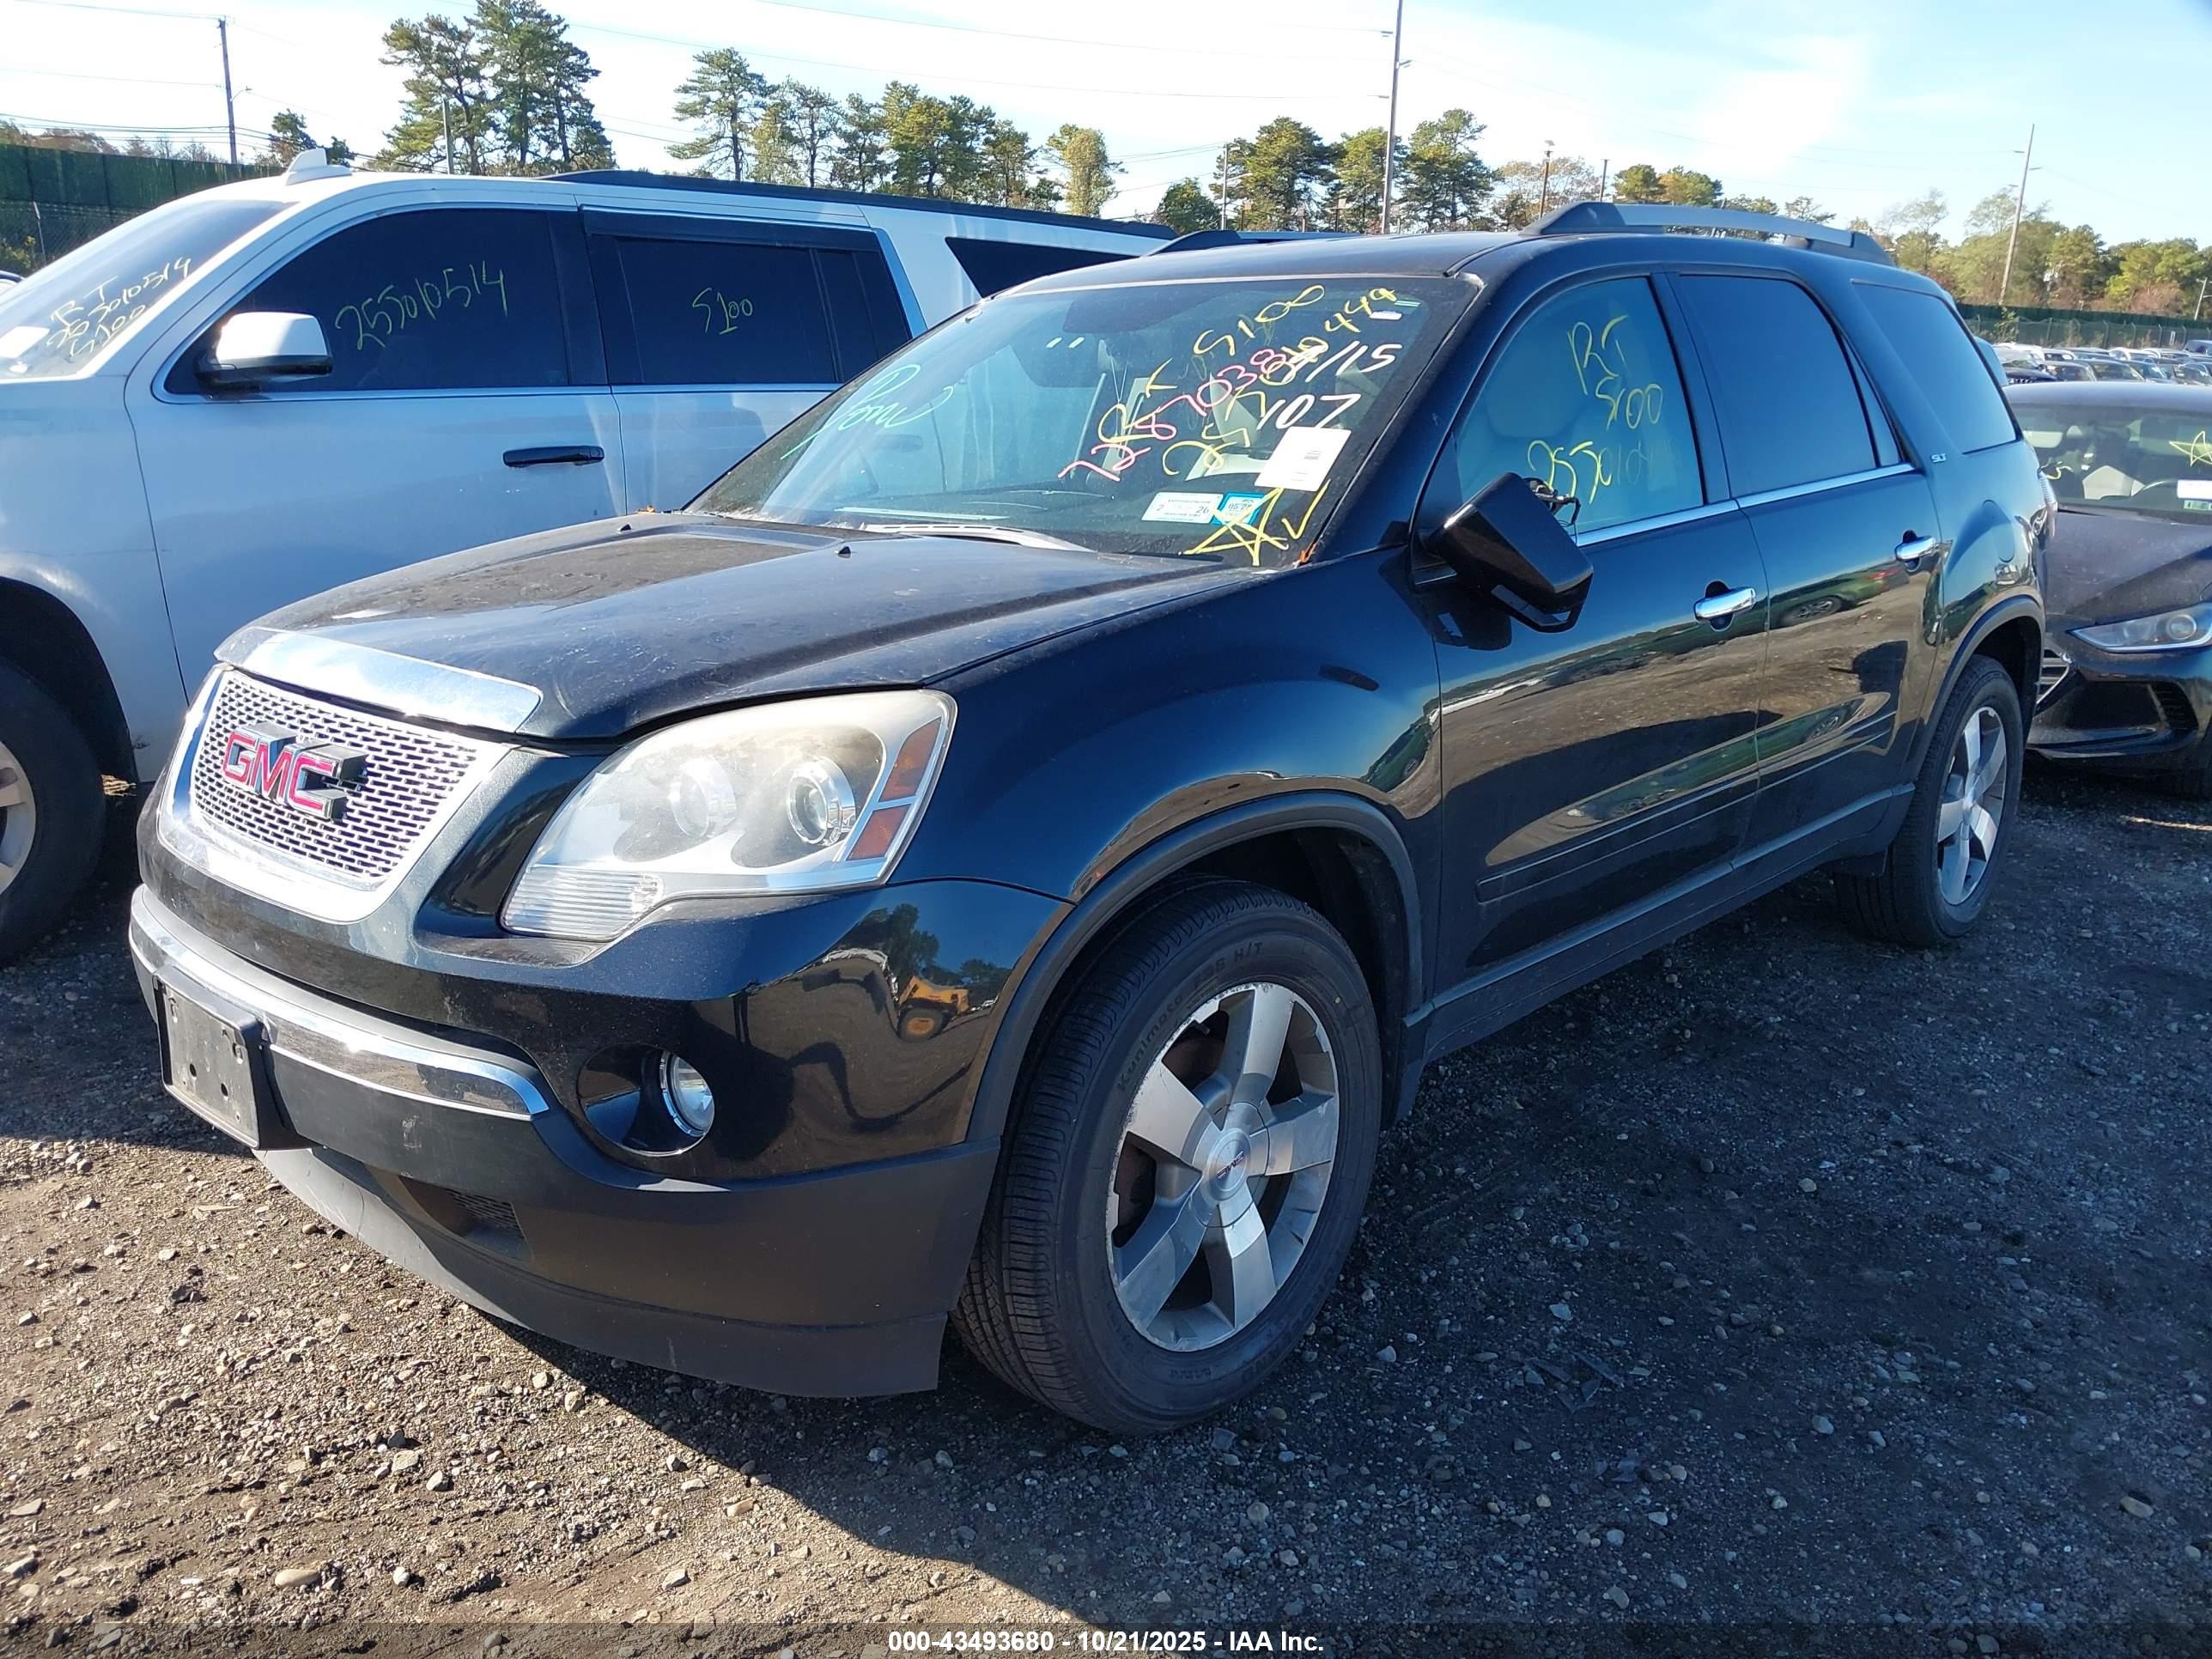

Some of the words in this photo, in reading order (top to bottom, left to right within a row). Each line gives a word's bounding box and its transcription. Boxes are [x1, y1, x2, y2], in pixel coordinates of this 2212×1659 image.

[335, 260, 508, 350] 255010514
[1930, 453, 1947, 463] SLT
[222, 726, 346, 820] GMC
[1234, 941, 1264, 963] H/T
